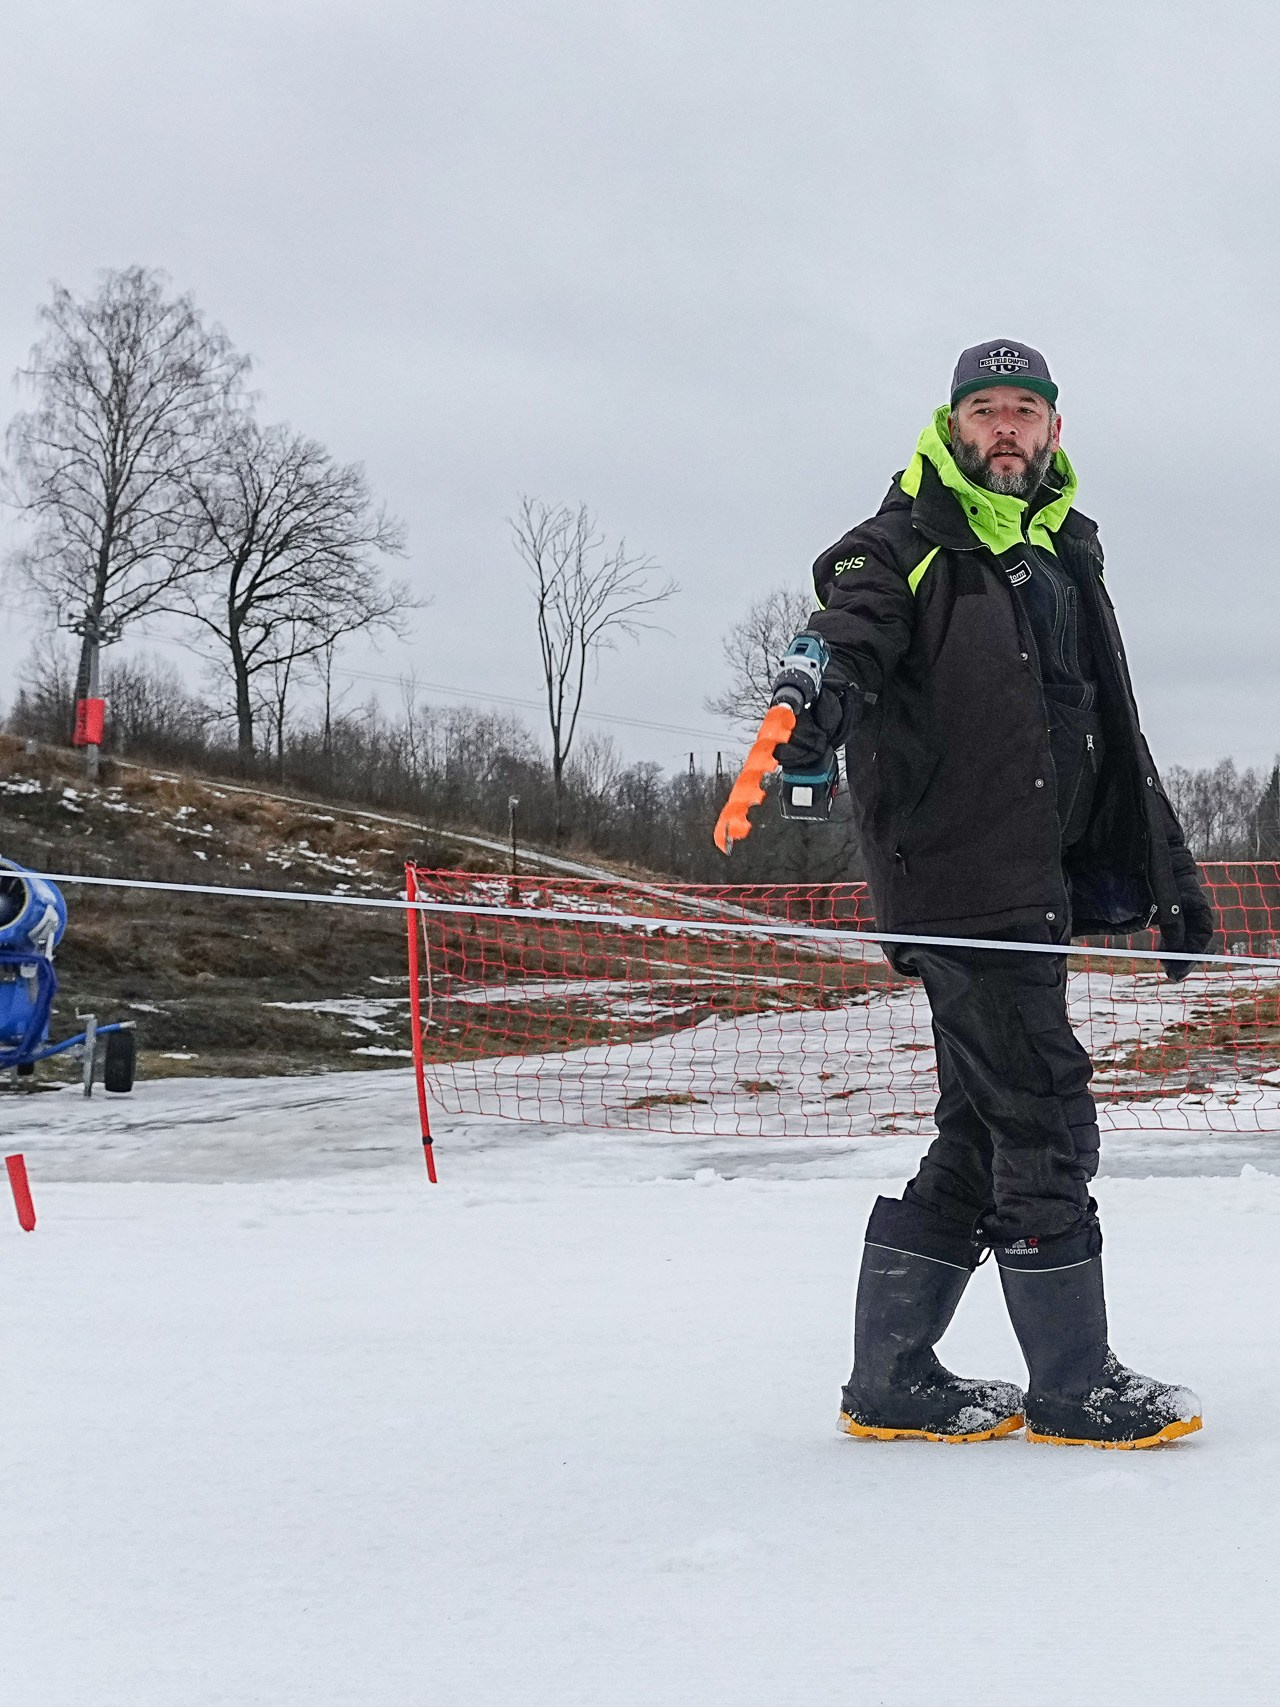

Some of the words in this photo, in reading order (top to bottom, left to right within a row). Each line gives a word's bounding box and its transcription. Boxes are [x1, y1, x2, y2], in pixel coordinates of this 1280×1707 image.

[1008, 357, 1028, 367] CHAPTER
[1008, 569, 1026, 582] torm
[1004, 1247, 1039, 1255] Nordman
